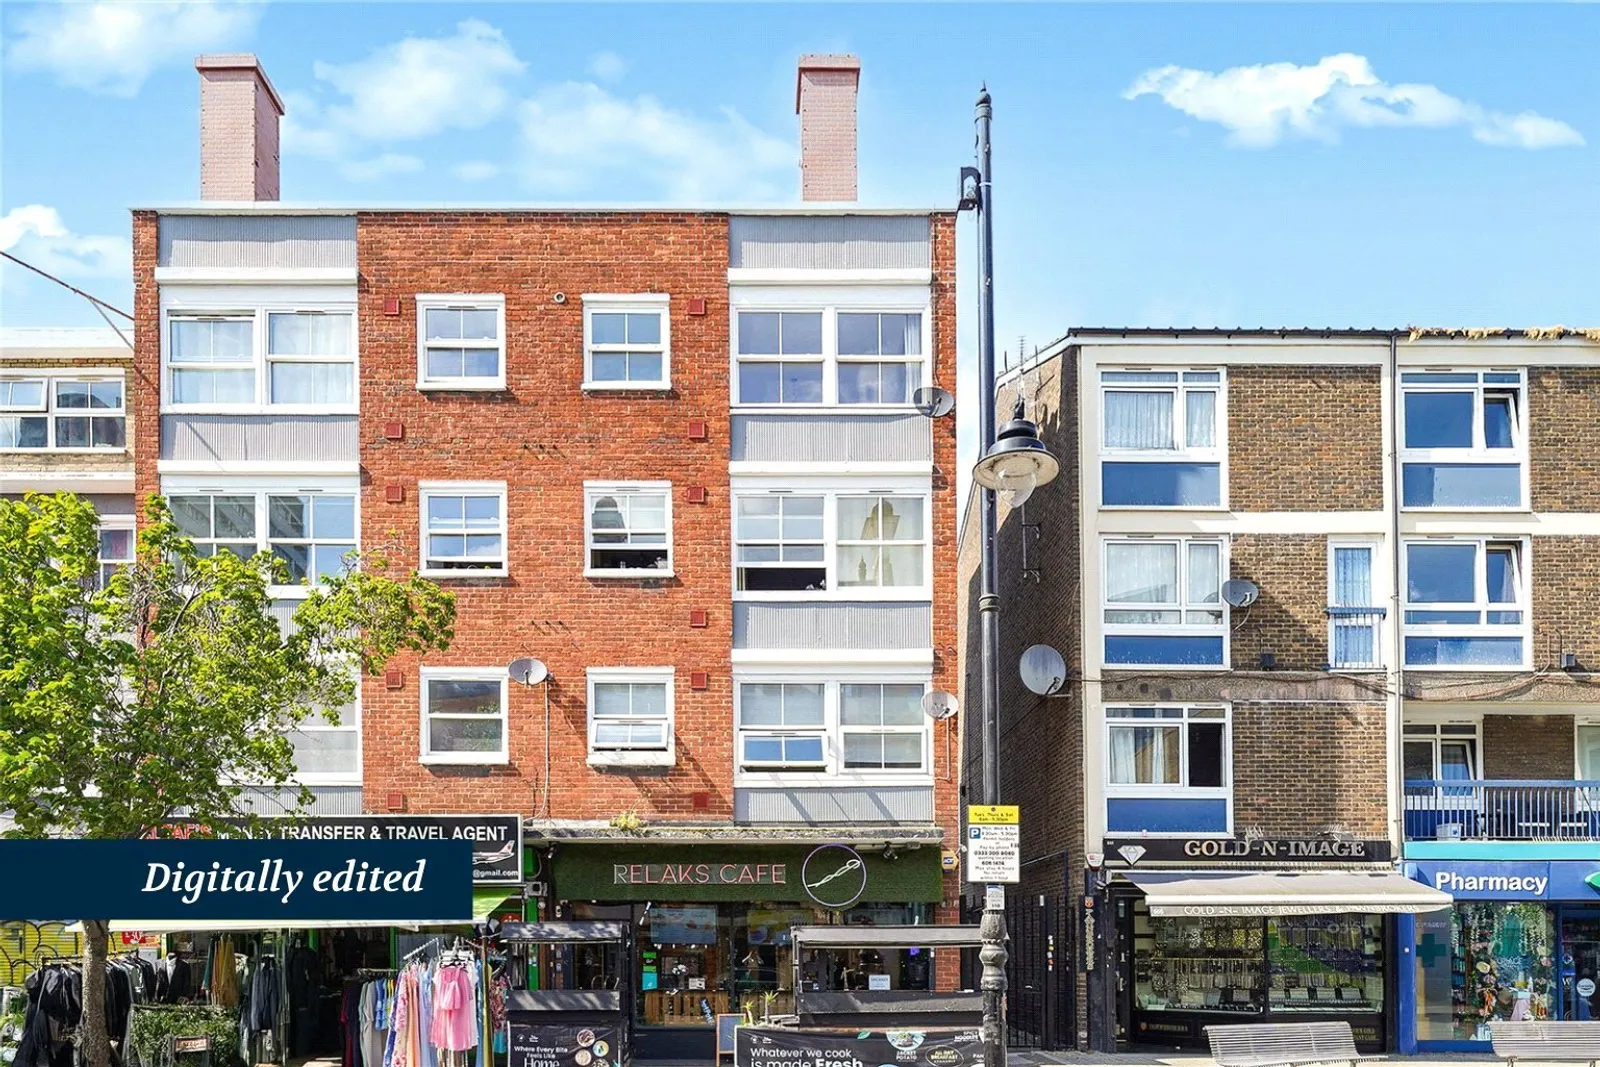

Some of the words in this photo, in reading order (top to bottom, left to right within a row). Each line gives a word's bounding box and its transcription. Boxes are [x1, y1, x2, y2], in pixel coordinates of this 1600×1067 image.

[279, 826, 364, 840] TRANSFER
[370, 826, 382, 840] &
[386, 826, 448, 840] TRAVEL
[452, 826, 508, 842] AGENT
[1184, 840, 1366, 857] GOLD-N-IMAGE
[472, 868, 518, 878] @gmail.com
[614, 864, 709, 884] RELAKS
[719, 864, 786, 884] CAFE
[1436, 872, 1548, 896] Pharmacy
[1184, 906, 1214, 914] GOLD
[1242, 906, 1275, 914] IMAGE
[1278, 905, 1330, 914] JEWELLERS
[750, 1048, 804, 1058] Whatever
[825, 1048, 852, 1058] cook
[524, 1058, 560, 1067] Home
[751, 1058, 762, 1067] is
[766, 1058, 812, 1067] made
[816, 1058, 863, 1067] Fresh
